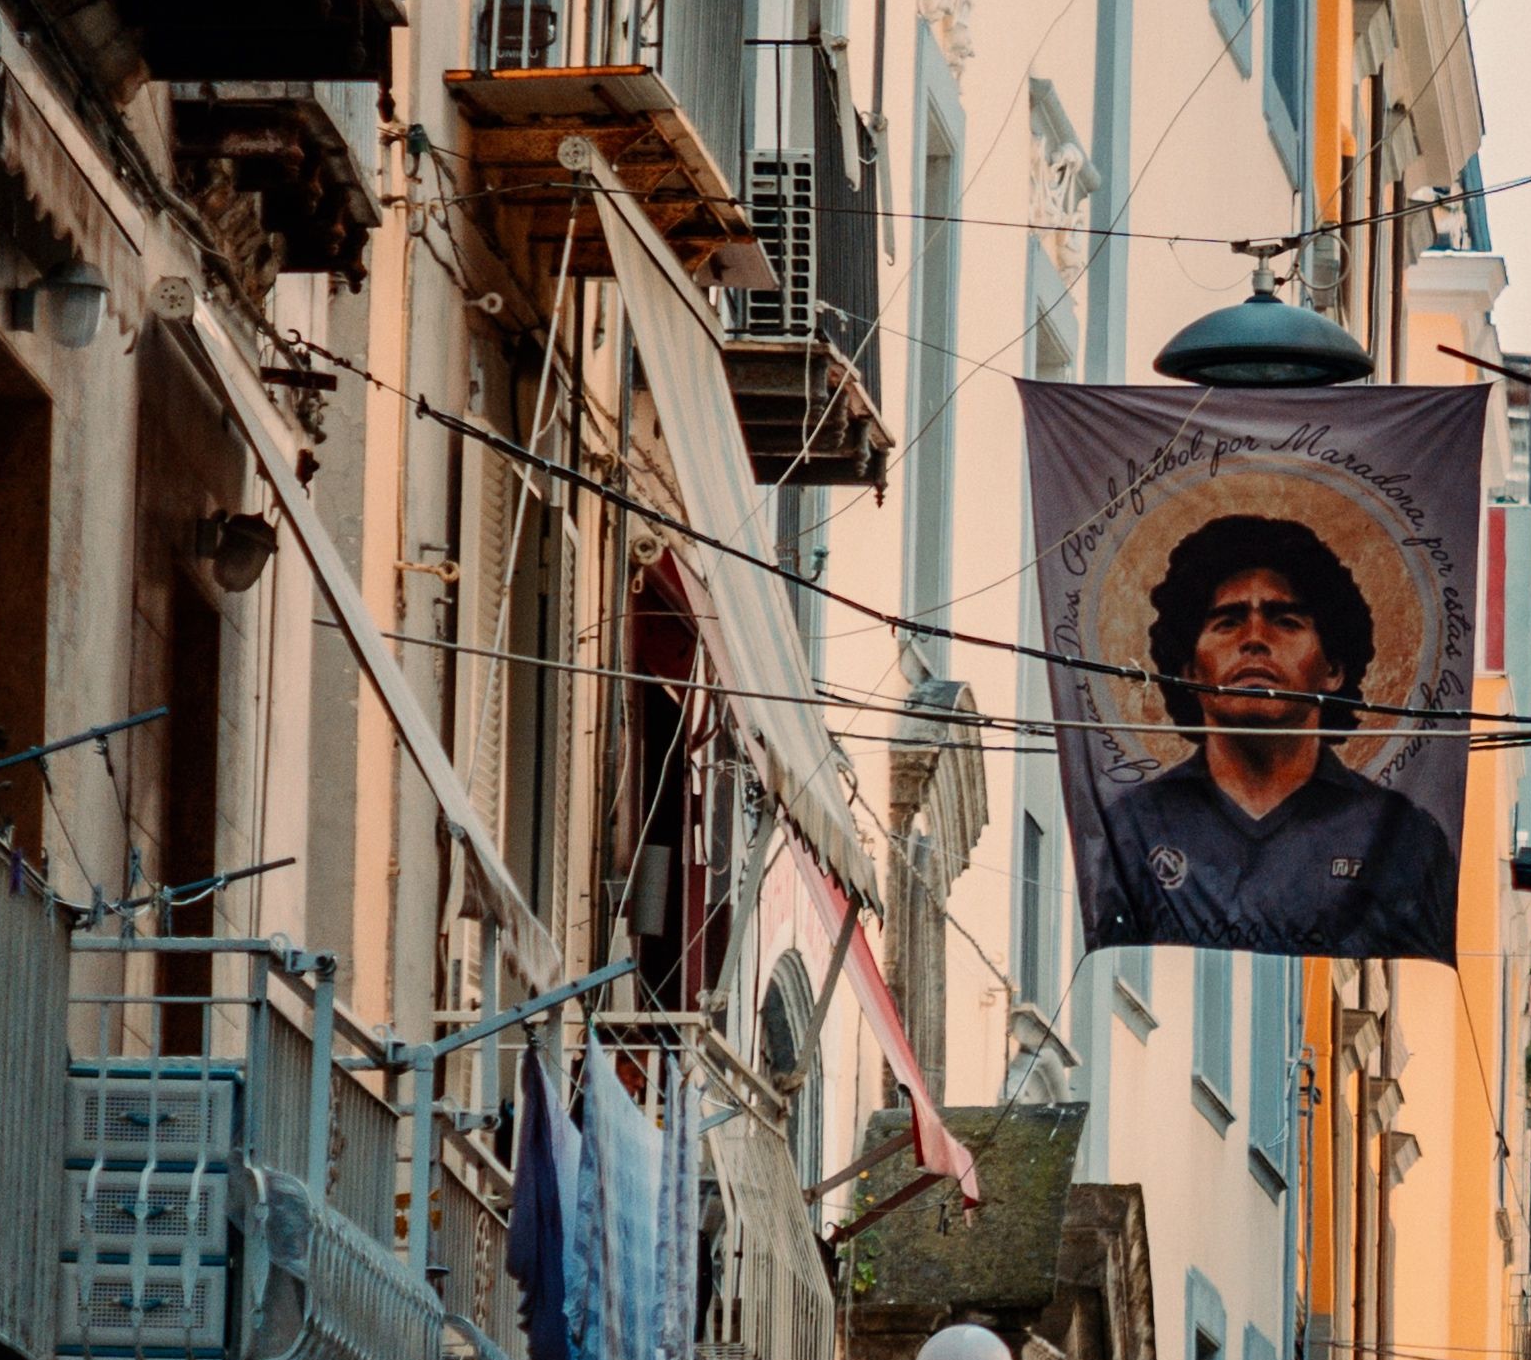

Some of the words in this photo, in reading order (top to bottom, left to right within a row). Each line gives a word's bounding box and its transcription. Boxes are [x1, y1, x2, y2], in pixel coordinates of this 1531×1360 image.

[1061, 523, 1105, 577] Por
[1105, 477, 1125, 520] el
[1210, 435, 1260, 478] por
[1401, 536, 1455, 578] por
[1442, 585, 1471, 661] estas
